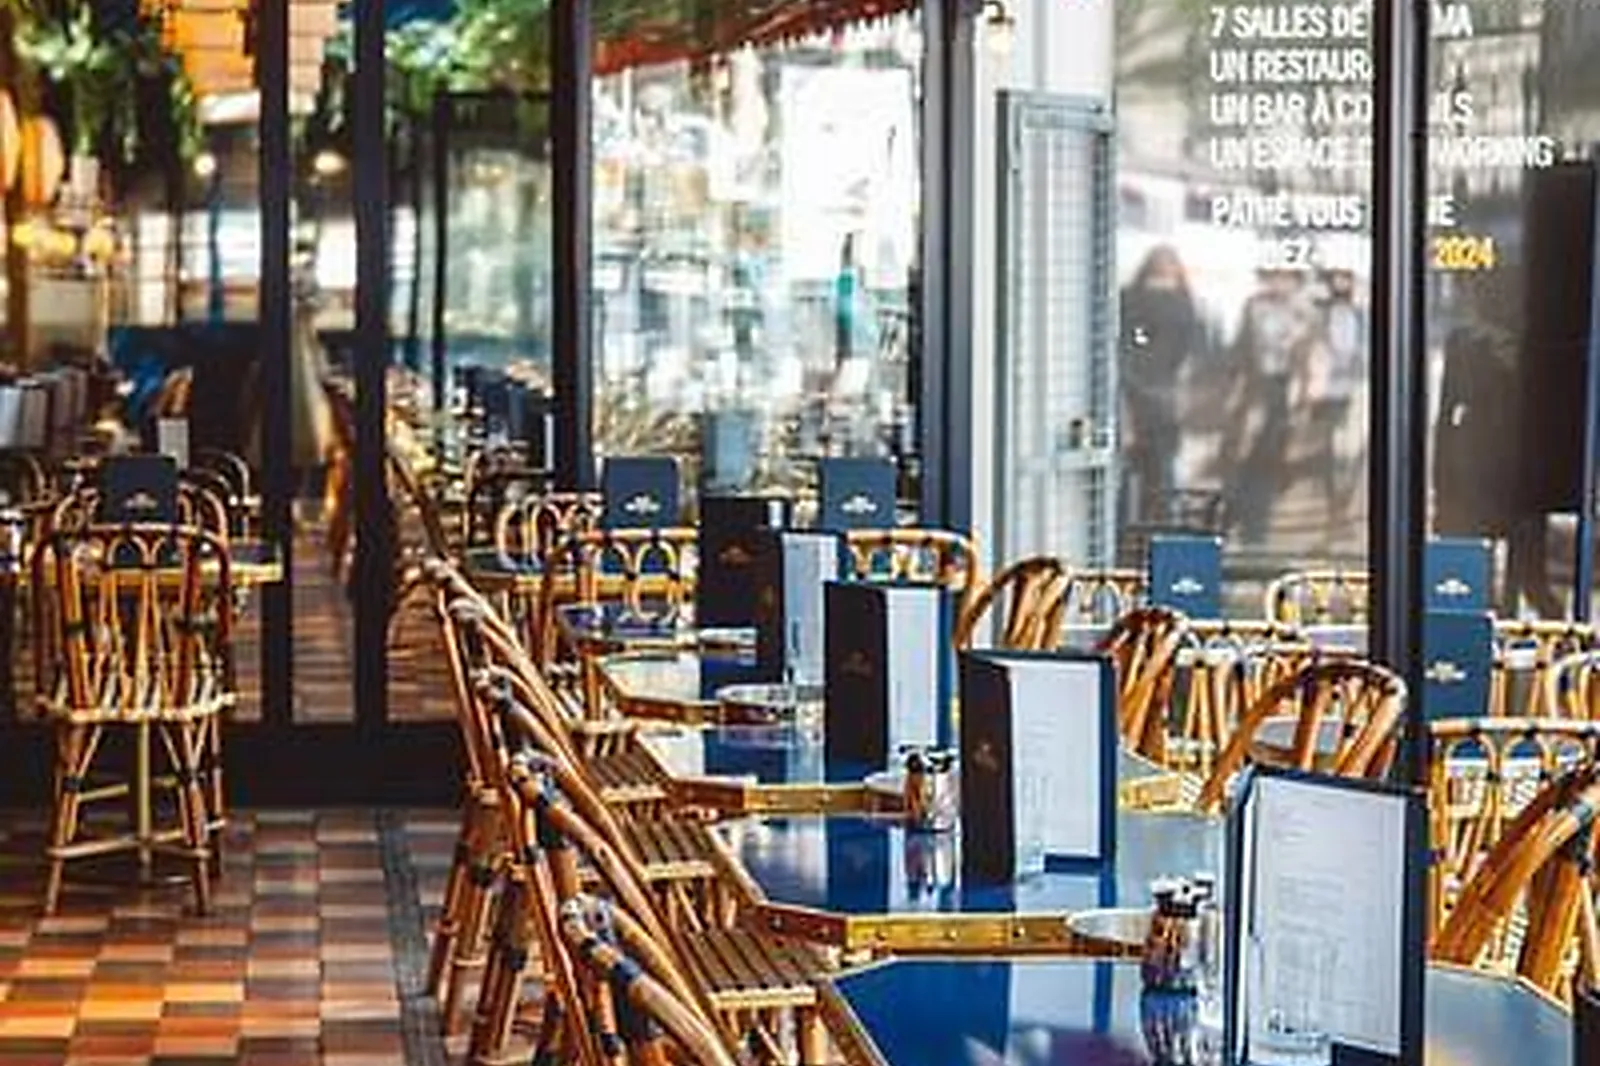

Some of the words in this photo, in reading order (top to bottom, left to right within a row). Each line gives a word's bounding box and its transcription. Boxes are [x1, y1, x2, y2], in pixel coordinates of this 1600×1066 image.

[1210, 5, 1227, 38] 7
[1231, 4, 1328, 38] SALLES
[1331, 4, 1369, 38] DE
[1210, 49, 1248, 83] UN
[1253, 49, 1373, 83] RESTAUR
[1210, 93, 1248, 126] UN
[1254, 93, 1306, 125] BAR
[1291, 195, 1362, 227] VOUS
